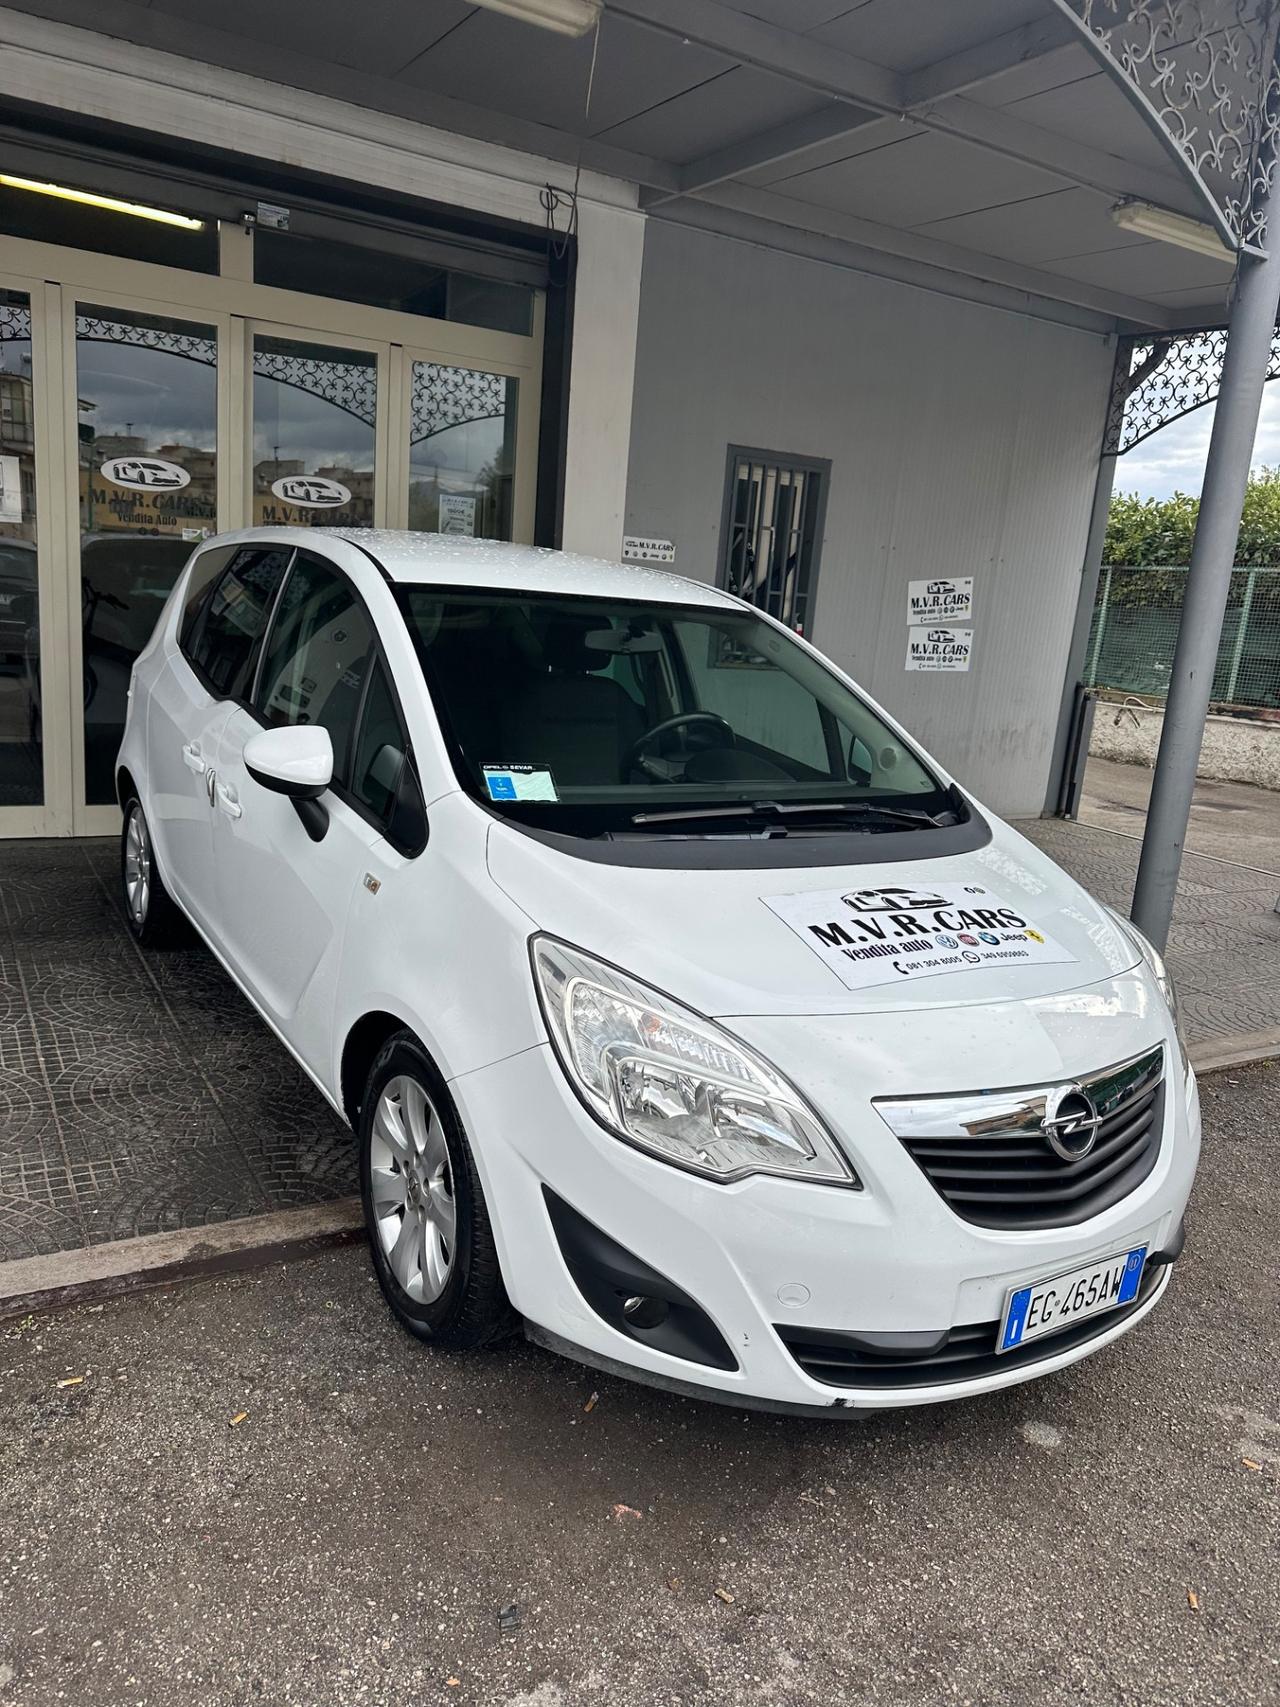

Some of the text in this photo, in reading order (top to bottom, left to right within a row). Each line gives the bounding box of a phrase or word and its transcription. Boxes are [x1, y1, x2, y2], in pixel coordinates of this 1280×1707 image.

[639, 541, 674, 552] M.V.R.CARS
[911, 593, 971, 609] M.V.R.CARS
[911, 643, 970, 656] M.V.R.CARS
[807, 908, 1027, 948] M.V.R.CARS
[1000, 932, 1028, 942] Jeep
[841, 938, 934, 961] Vendita auto
[905, 962, 922, 970] 081
[924, 959, 941, 967] 304
